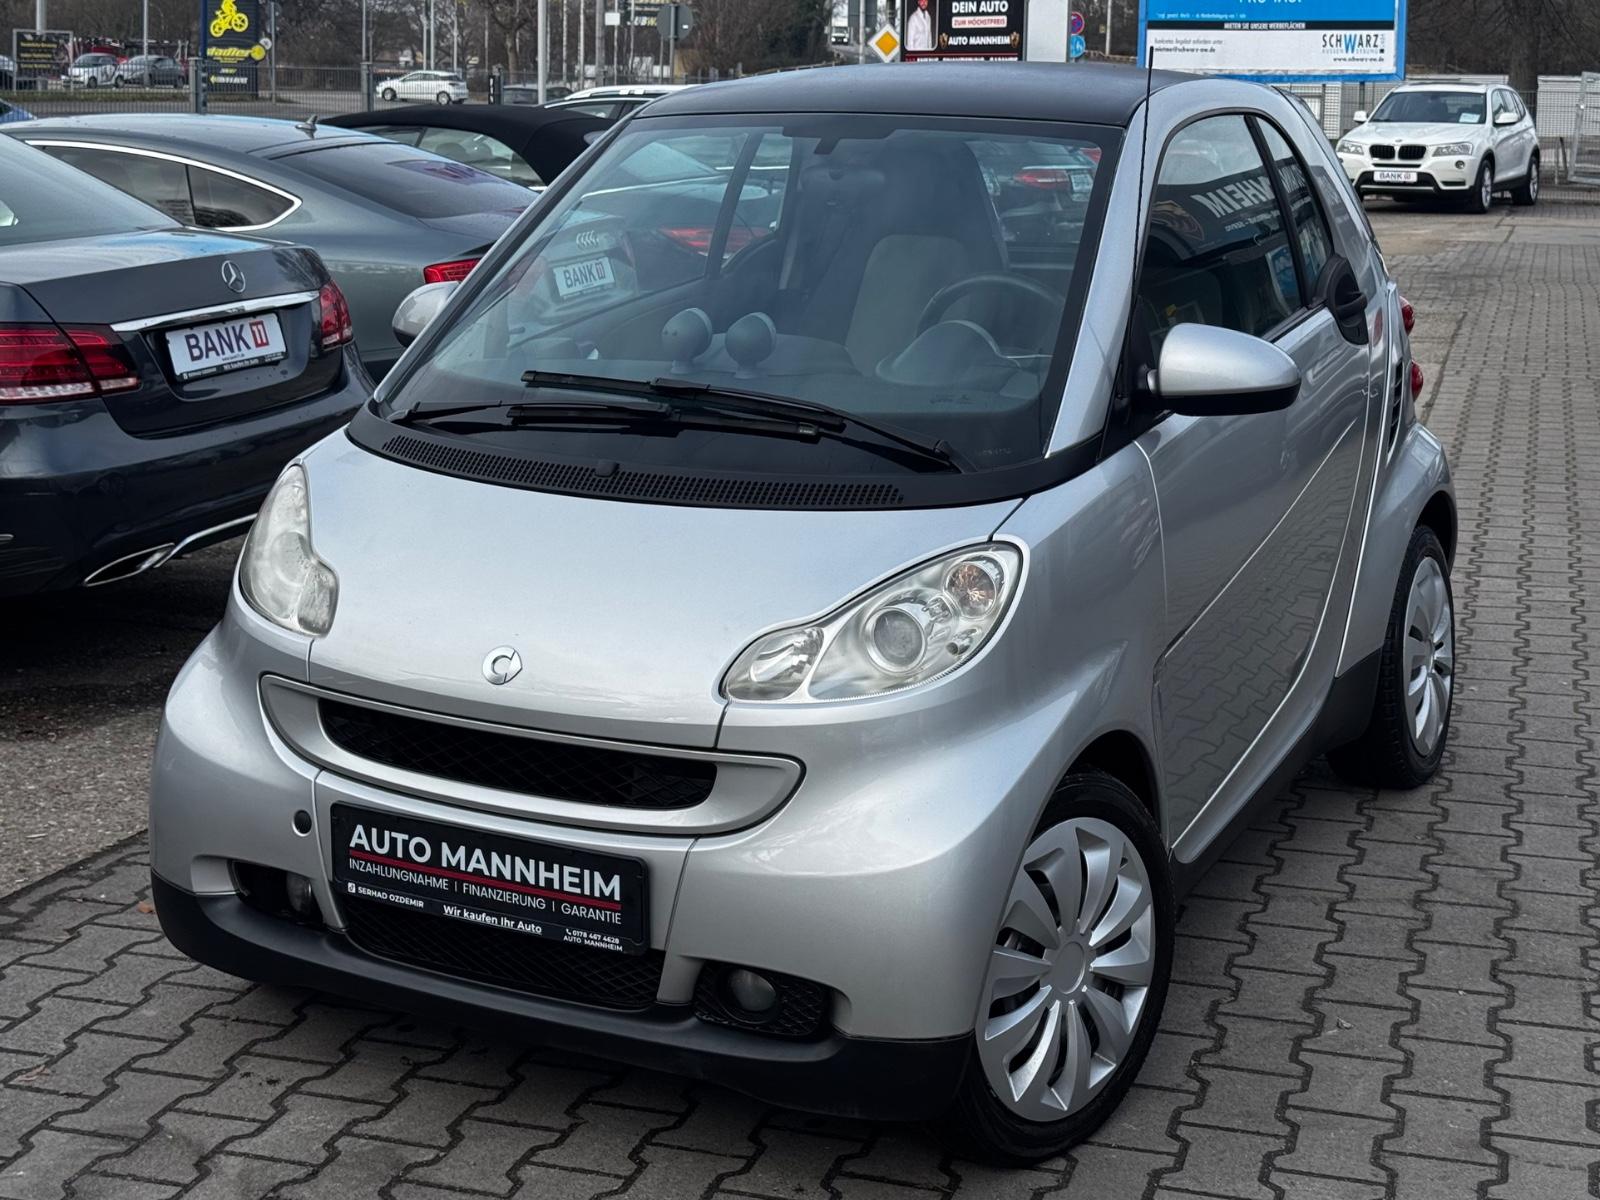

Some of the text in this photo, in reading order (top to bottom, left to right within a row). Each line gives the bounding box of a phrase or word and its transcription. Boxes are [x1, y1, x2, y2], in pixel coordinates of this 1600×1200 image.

[952, 0, 1009, 14] DEIN AUTO
[968, 17, 1006, 26] HÖCHSTPREIS
[948, 35, 1011, 46] AUTO MANNHEIM
[1322, 33, 1379, 54] SCHWARZ
[1379, 172, 1402, 181] BANK
[563, 262, 597, 289] BANK
[185, 321, 269, 362] BANK 11
[349, 824, 622, 901] AUTO MANNHEIM
[349, 858, 622, 925] INZAHLUNGNAHME FINANZIERUNG GARANTIE
[357, 886, 425, 908] SERHAD OZDEMIR
[443, 904, 542, 934] Wir kaufen Ihr Auto
[563, 935, 623, 952] AUTO MANNHEIM
